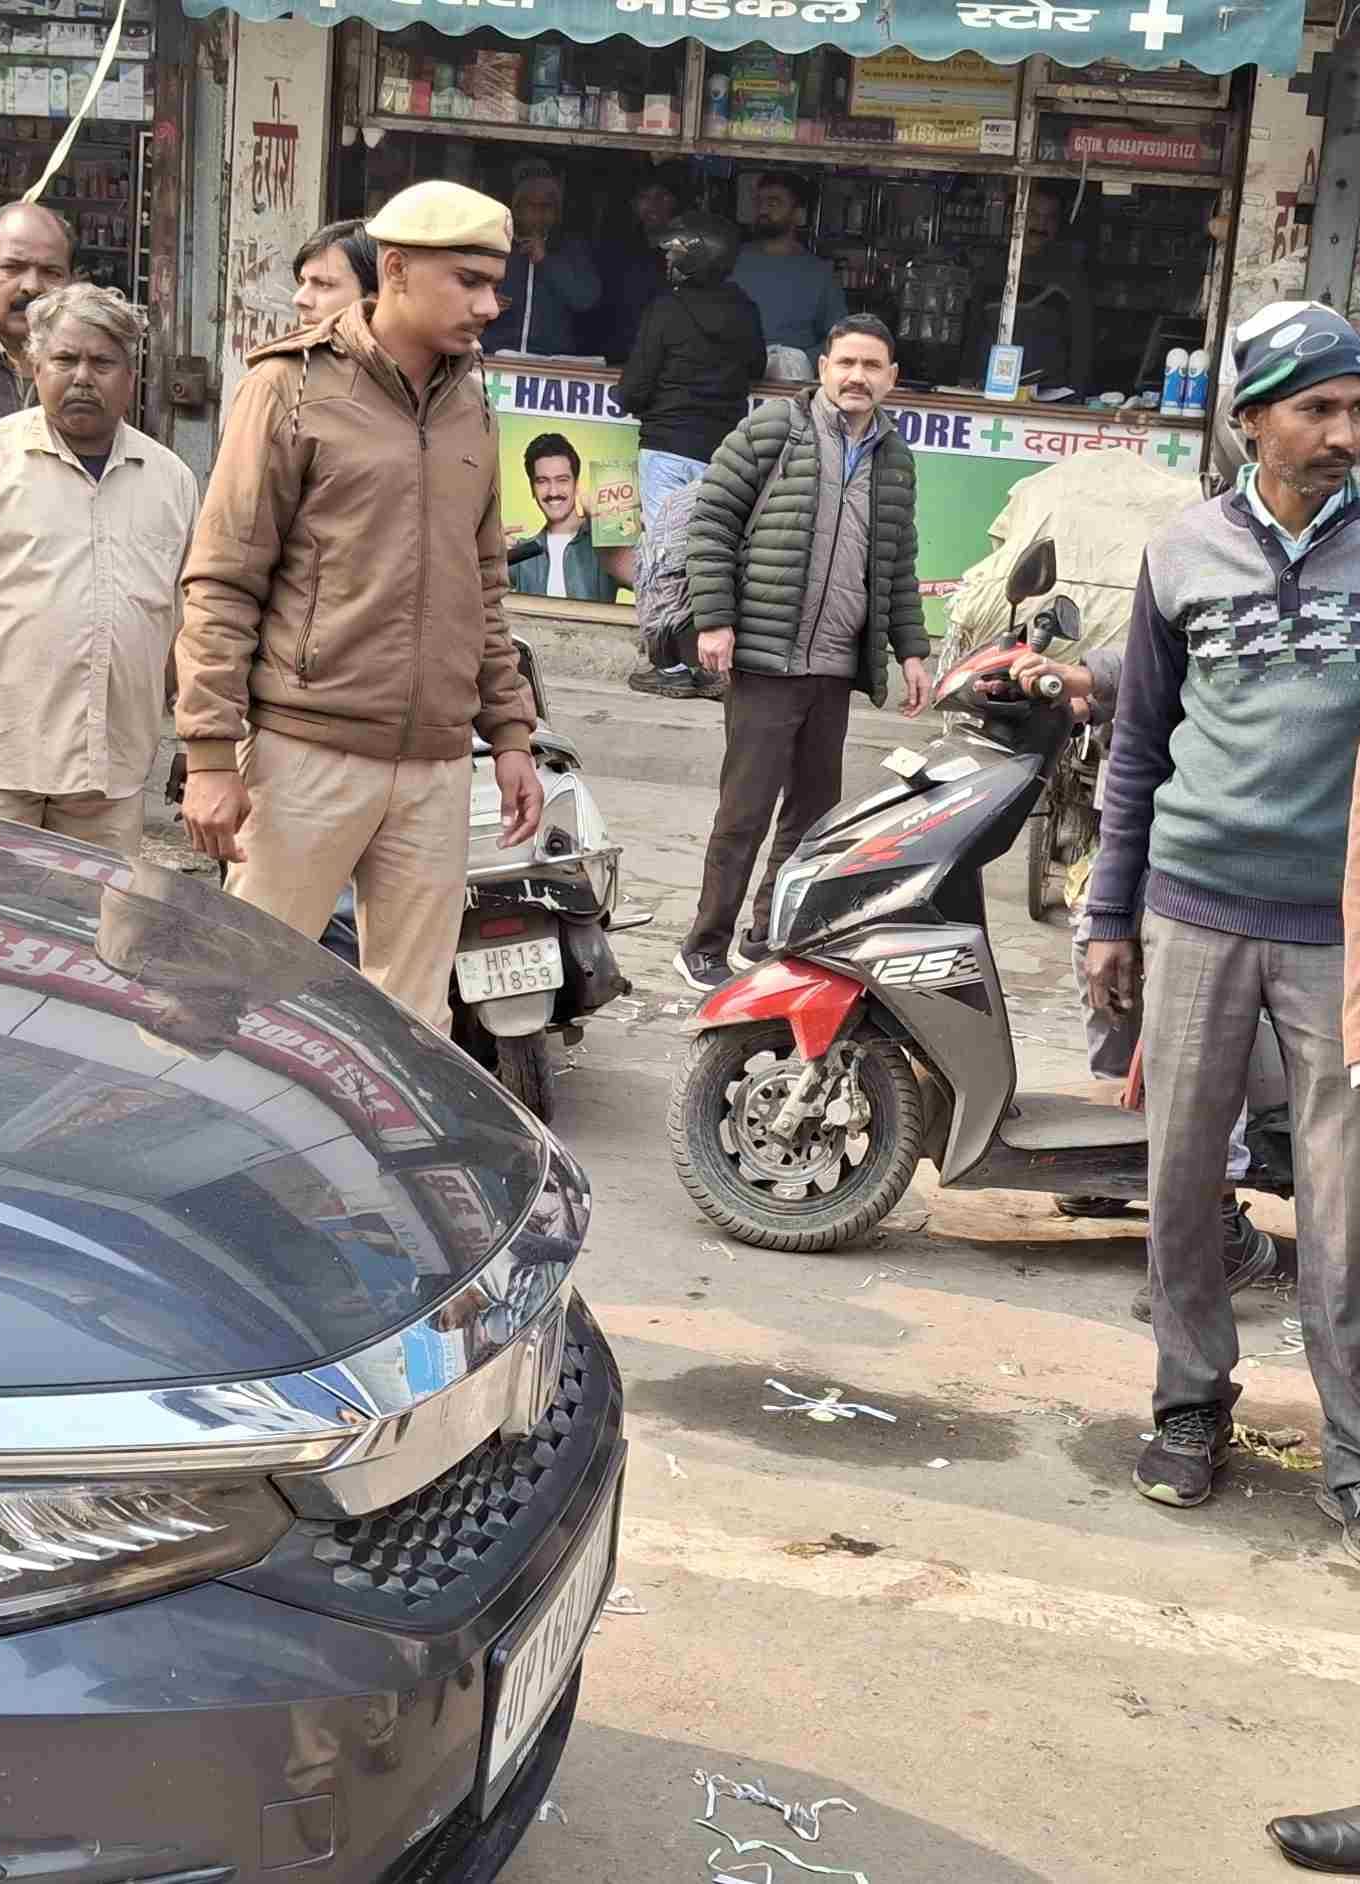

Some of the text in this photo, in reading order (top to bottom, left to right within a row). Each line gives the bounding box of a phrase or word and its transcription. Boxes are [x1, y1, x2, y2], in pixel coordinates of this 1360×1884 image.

[514, 375, 973, 450] HARIS ORE
[596, 483, 635, 506] ENO
[485, 943, 544, 972] HR13
[871, 949, 960, 985] 125
[481, 966, 553, 996] J1859
